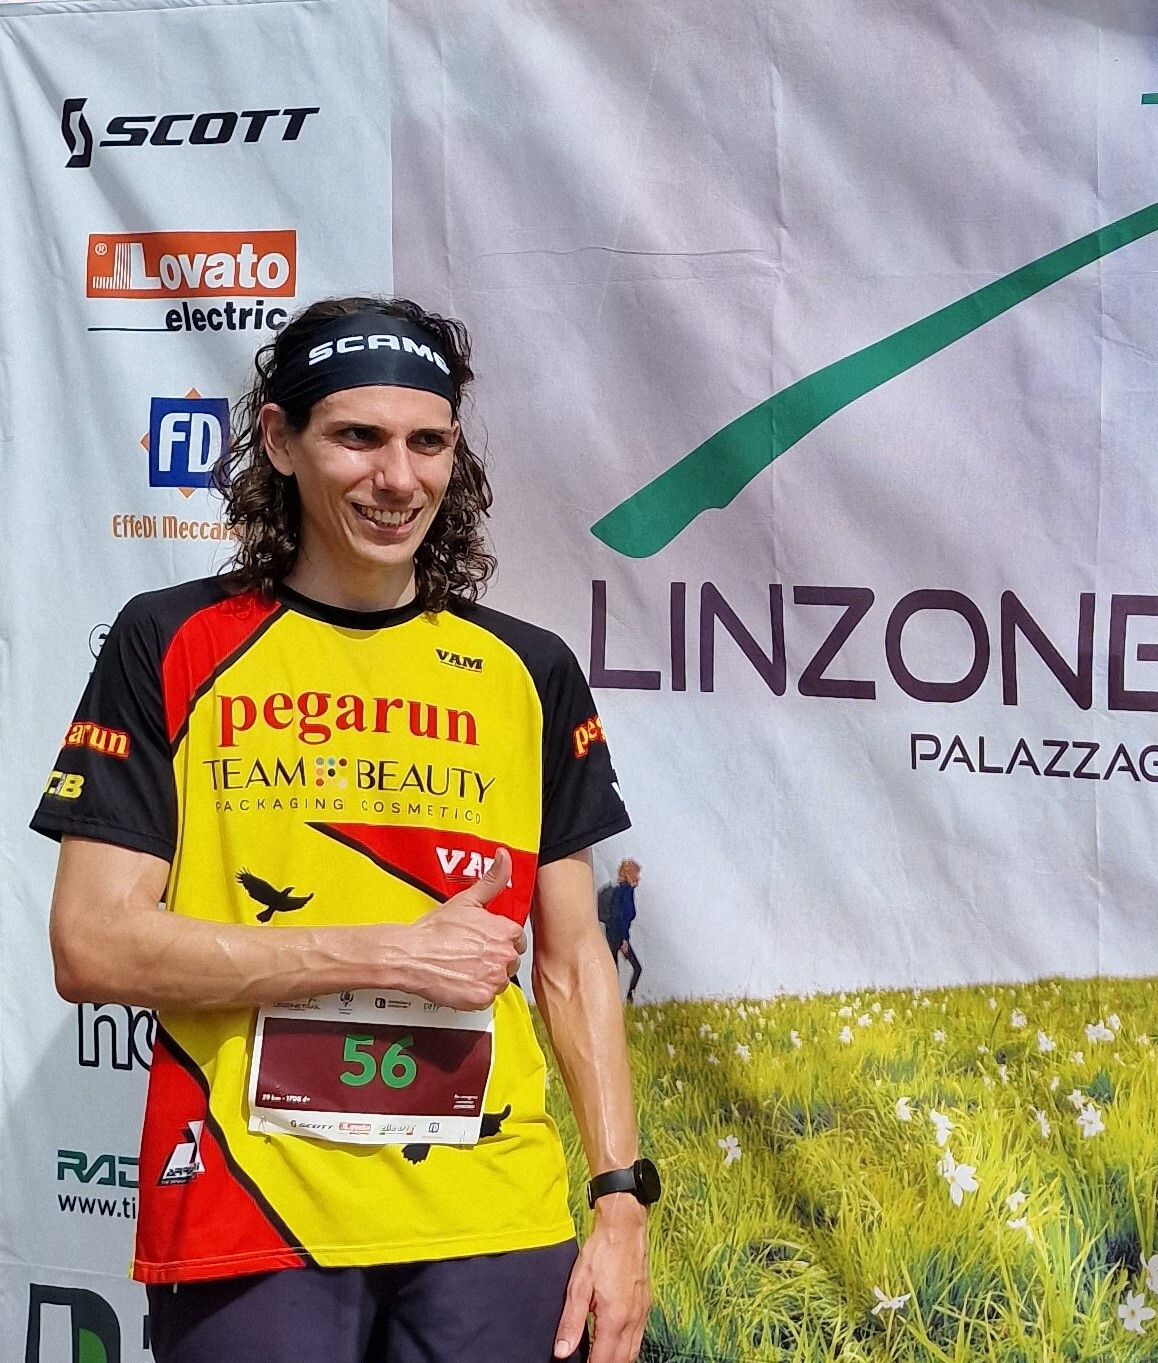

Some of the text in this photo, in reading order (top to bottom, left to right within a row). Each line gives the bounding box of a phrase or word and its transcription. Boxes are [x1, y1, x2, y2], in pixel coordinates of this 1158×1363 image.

[100, 107, 320, 147] SCOTT
[130, 243, 290, 290] Lovato
[165, 300, 288, 331] electric
[158, 412, 223, 473] FD
[112, 514, 157, 539] EffeDi
[436, 648, 483, 670] VAM
[217, 691, 480, 748] pegarun
[202, 756, 496, 803] TEAM BEAUTY
[215, 798, 481, 824] PACKAGING COSMETICO
[436, 847, 512, 889] VA
[339, 1034, 418, 1089] 56
[57, 1194, 136, 1220] www.ti
